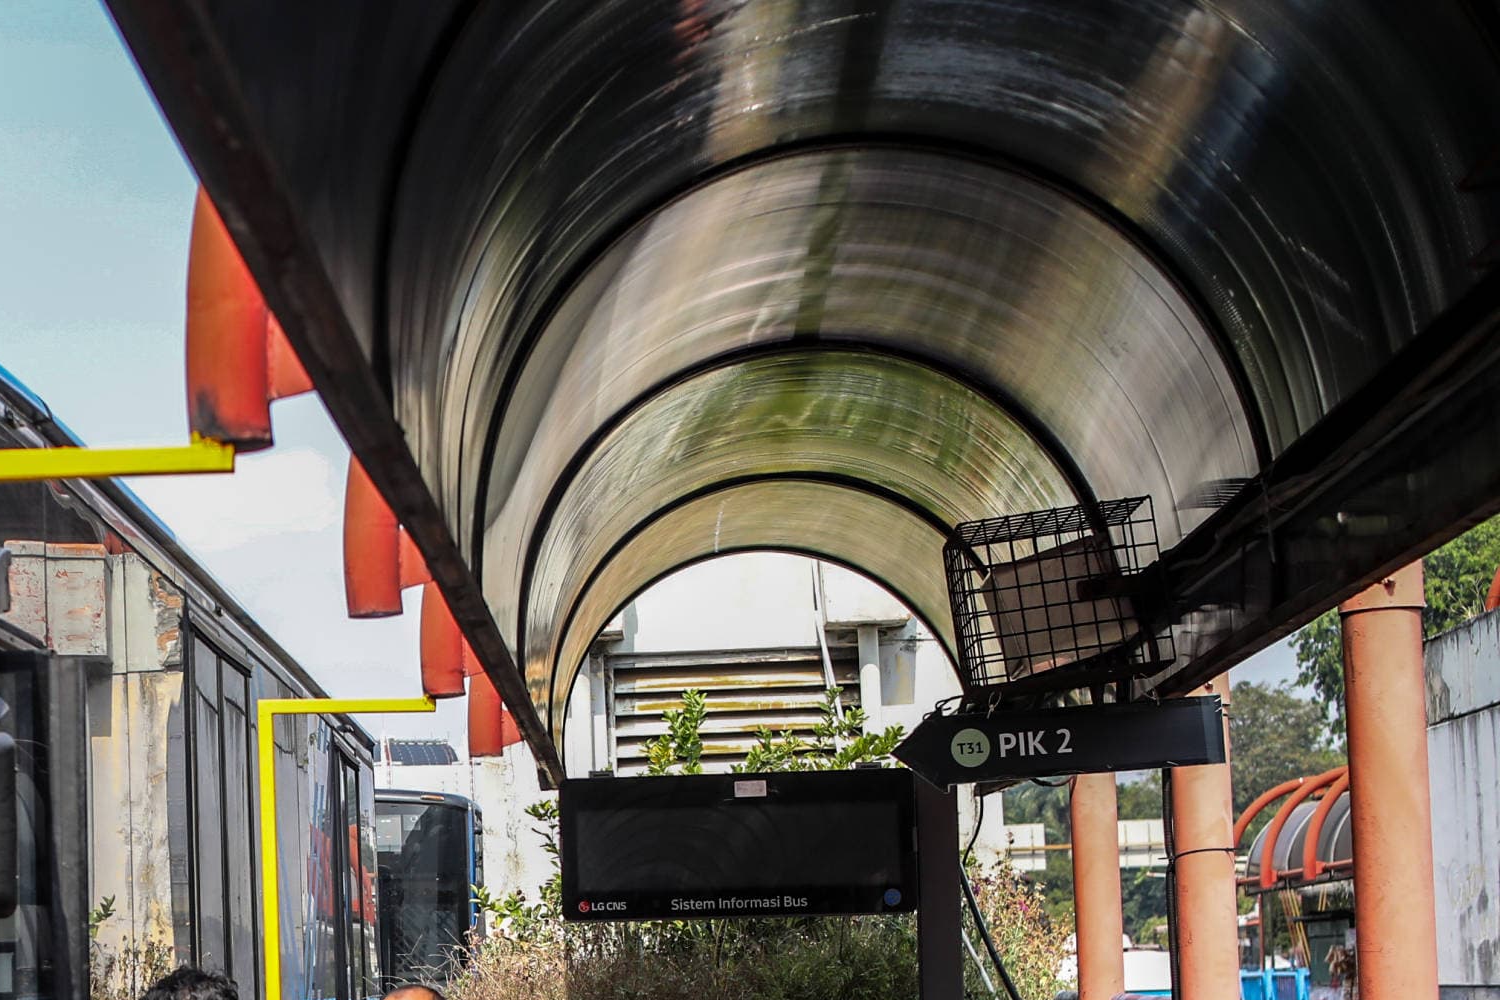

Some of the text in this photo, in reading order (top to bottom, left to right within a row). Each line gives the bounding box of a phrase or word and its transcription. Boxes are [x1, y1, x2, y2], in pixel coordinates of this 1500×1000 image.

[956, 728, 1073, 758] T31 PIK 2
[591, 901, 627, 911] LG CNS
[671, 896, 809, 911] Sistem Informasi Bus
